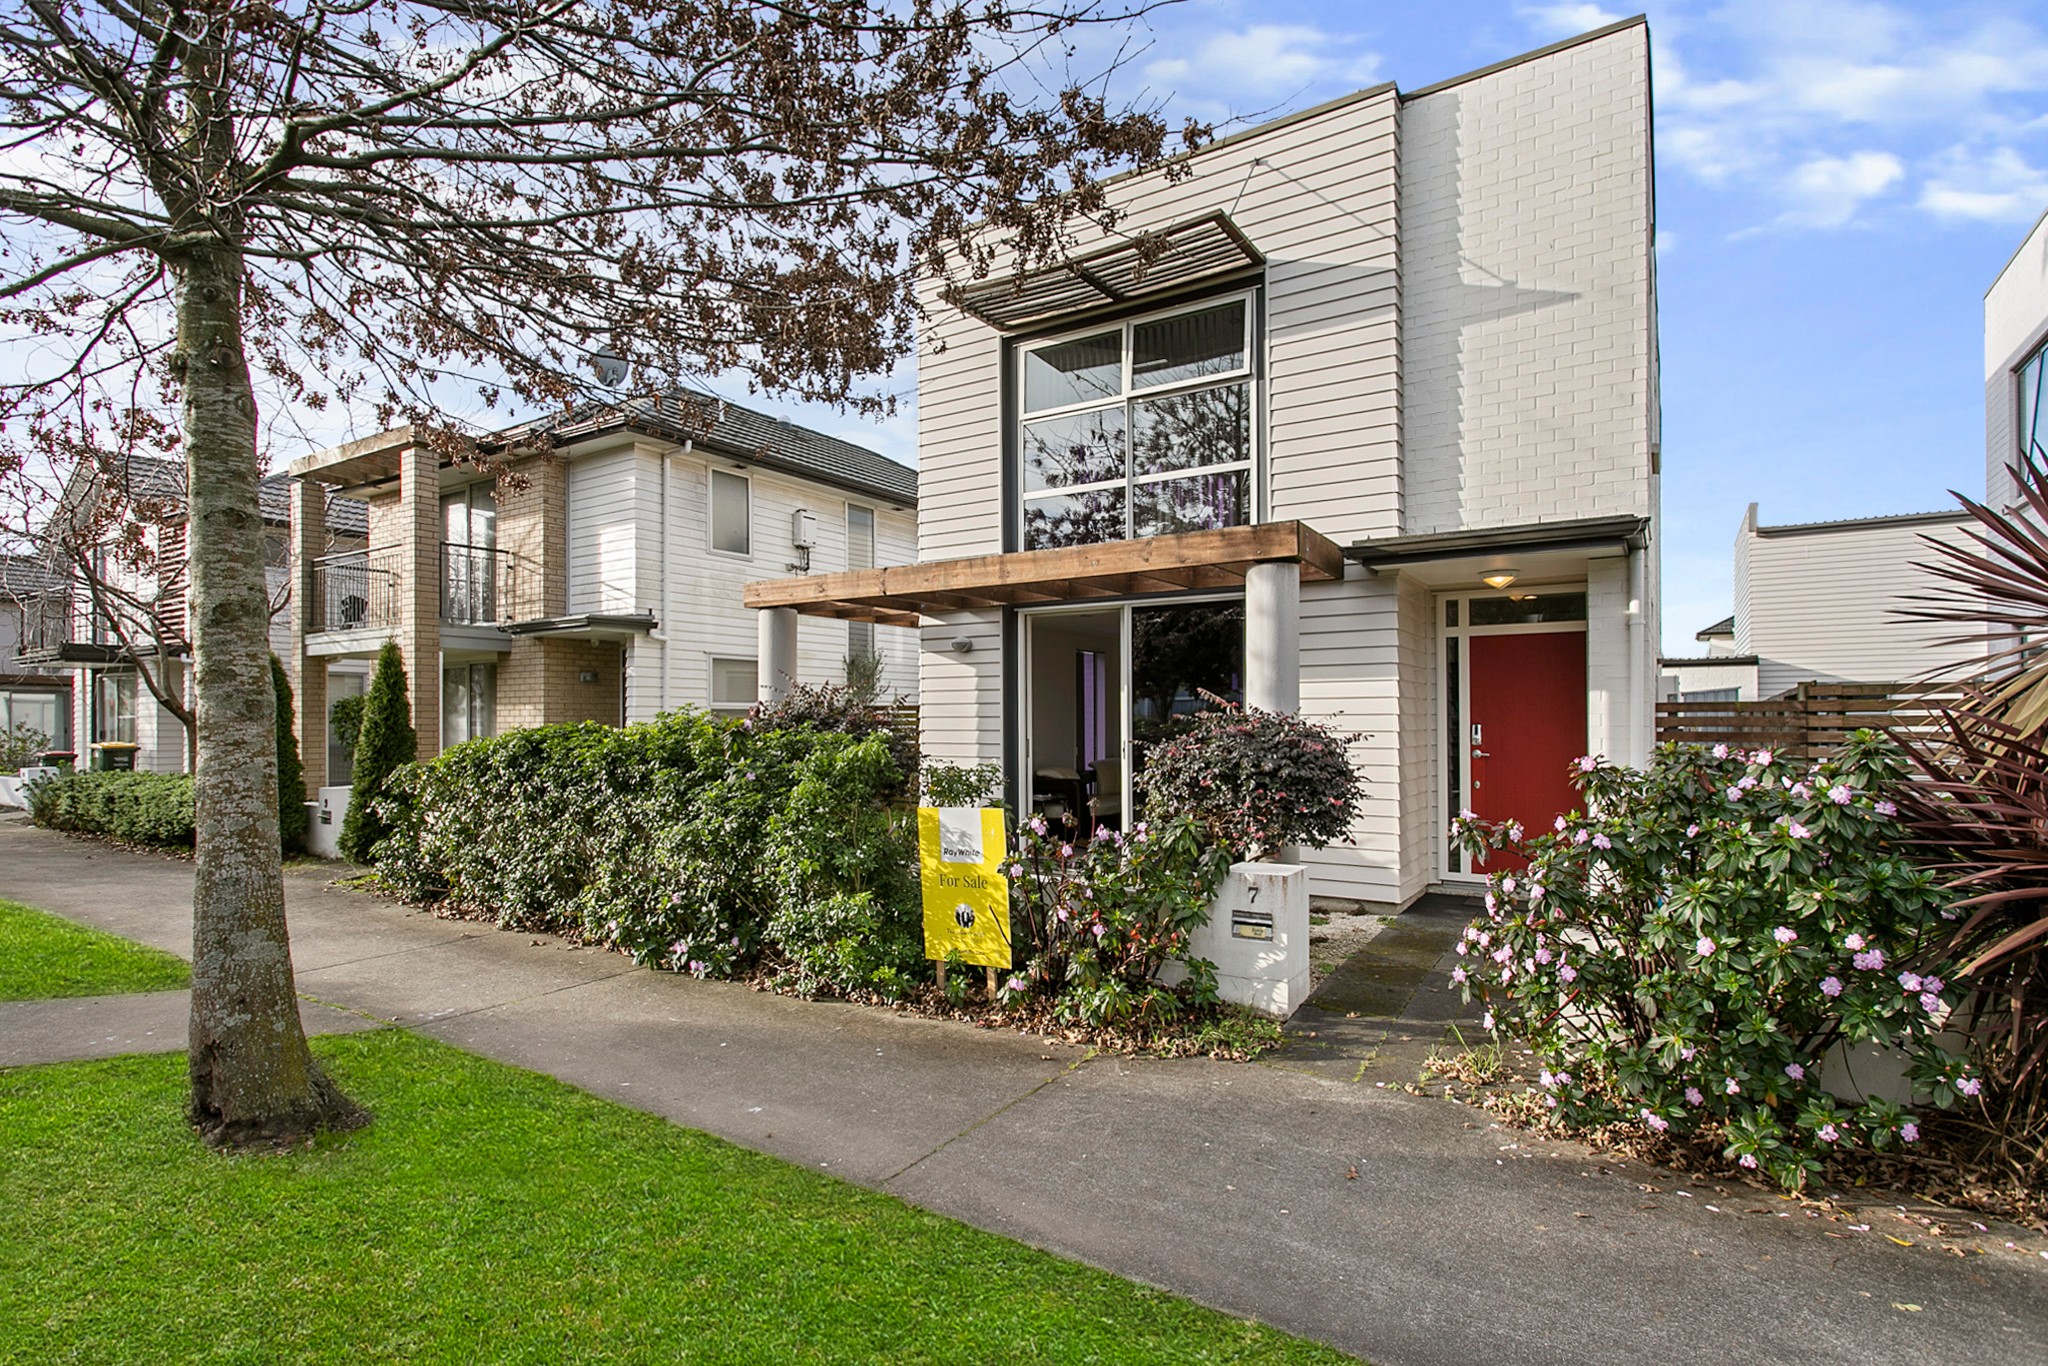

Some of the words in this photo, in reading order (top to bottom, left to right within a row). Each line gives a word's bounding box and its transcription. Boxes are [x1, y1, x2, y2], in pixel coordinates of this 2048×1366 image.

[939, 873, 960, 888] For
[962, 874, 988, 890] Sale
[1247, 886, 1259, 904] 7
